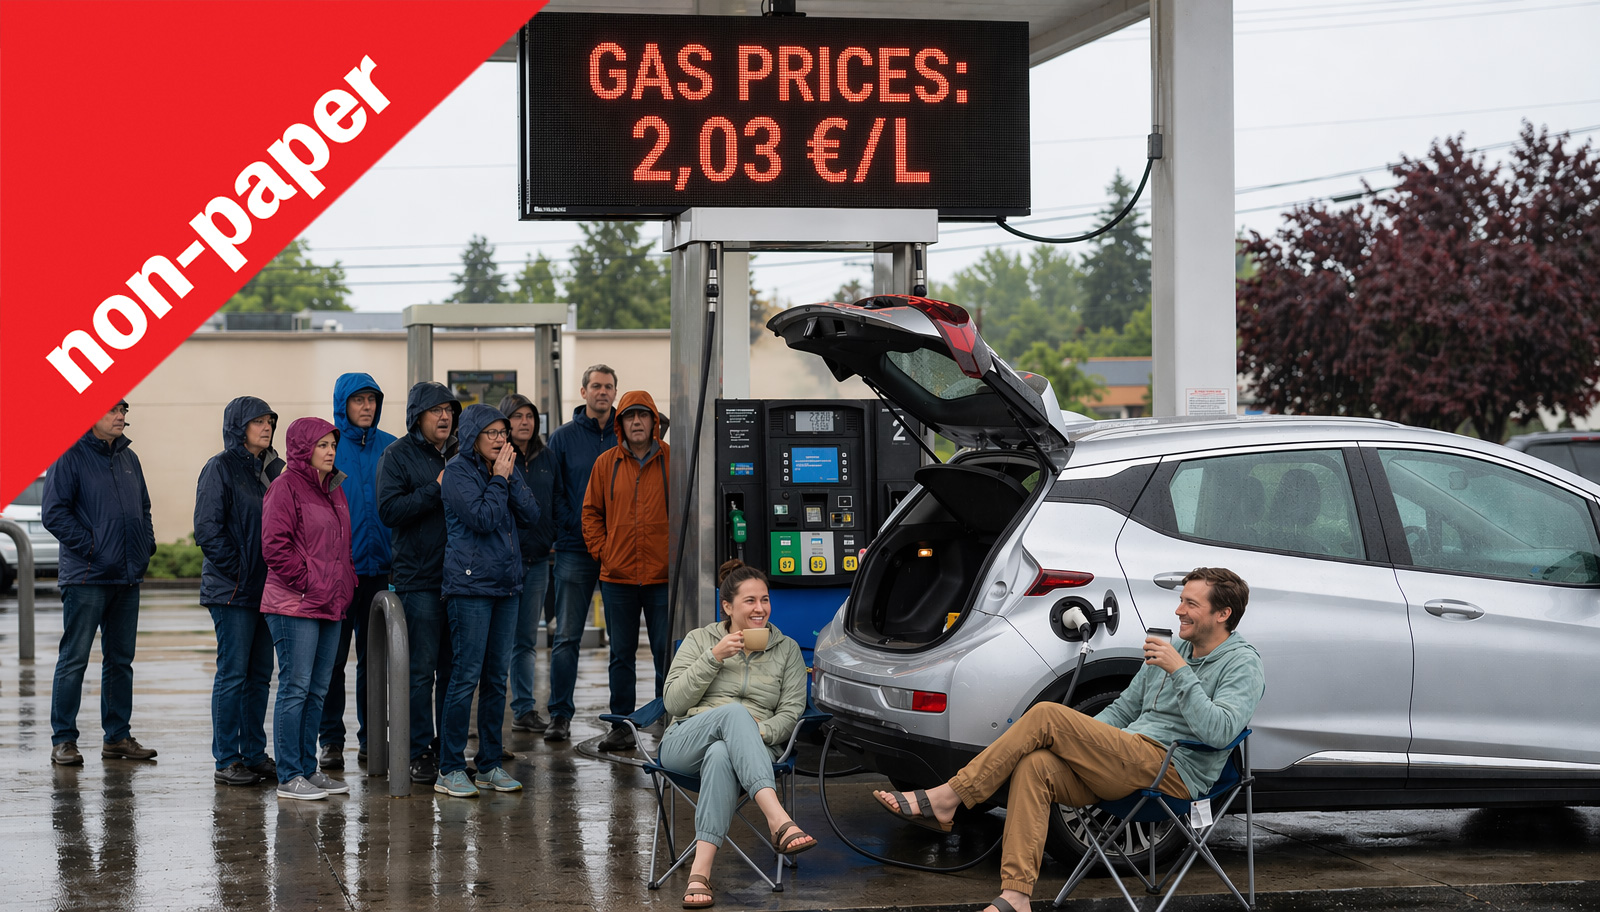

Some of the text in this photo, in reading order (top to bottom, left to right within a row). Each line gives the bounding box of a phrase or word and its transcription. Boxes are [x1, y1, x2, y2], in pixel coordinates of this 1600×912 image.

[589, 42, 968, 104] GAS PRICES:
[632, 115, 931, 191] 2,03 €/L
[892, 415, 906, 441] 2
